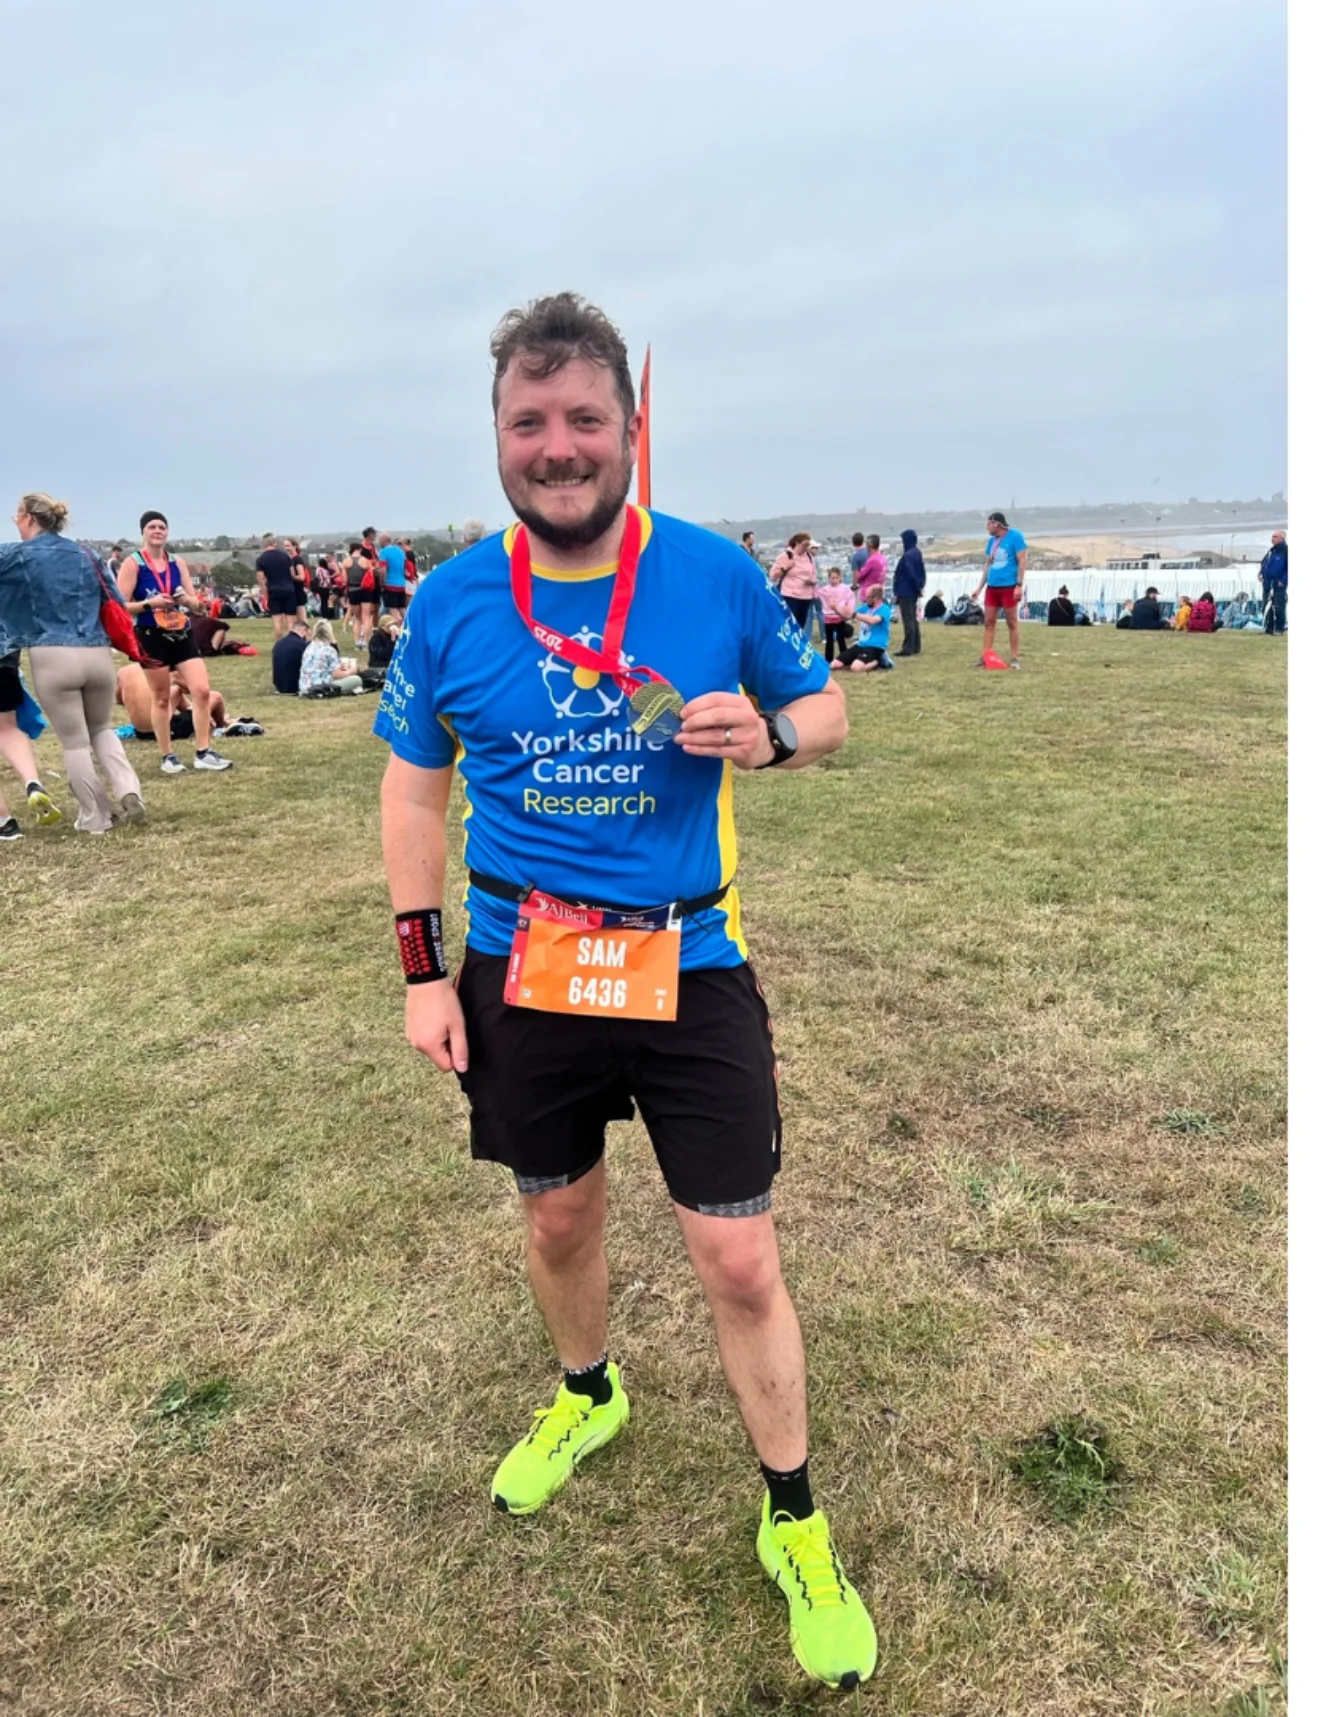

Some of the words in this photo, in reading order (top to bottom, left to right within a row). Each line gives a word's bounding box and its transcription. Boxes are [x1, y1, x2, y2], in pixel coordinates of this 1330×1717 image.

[533, 626, 564, 651] 2025
[533, 758, 644, 784] Cancer
[523, 788, 656, 815] Research
[577, 937, 627, 968] SAM
[568, 976, 627, 1008] 6436
